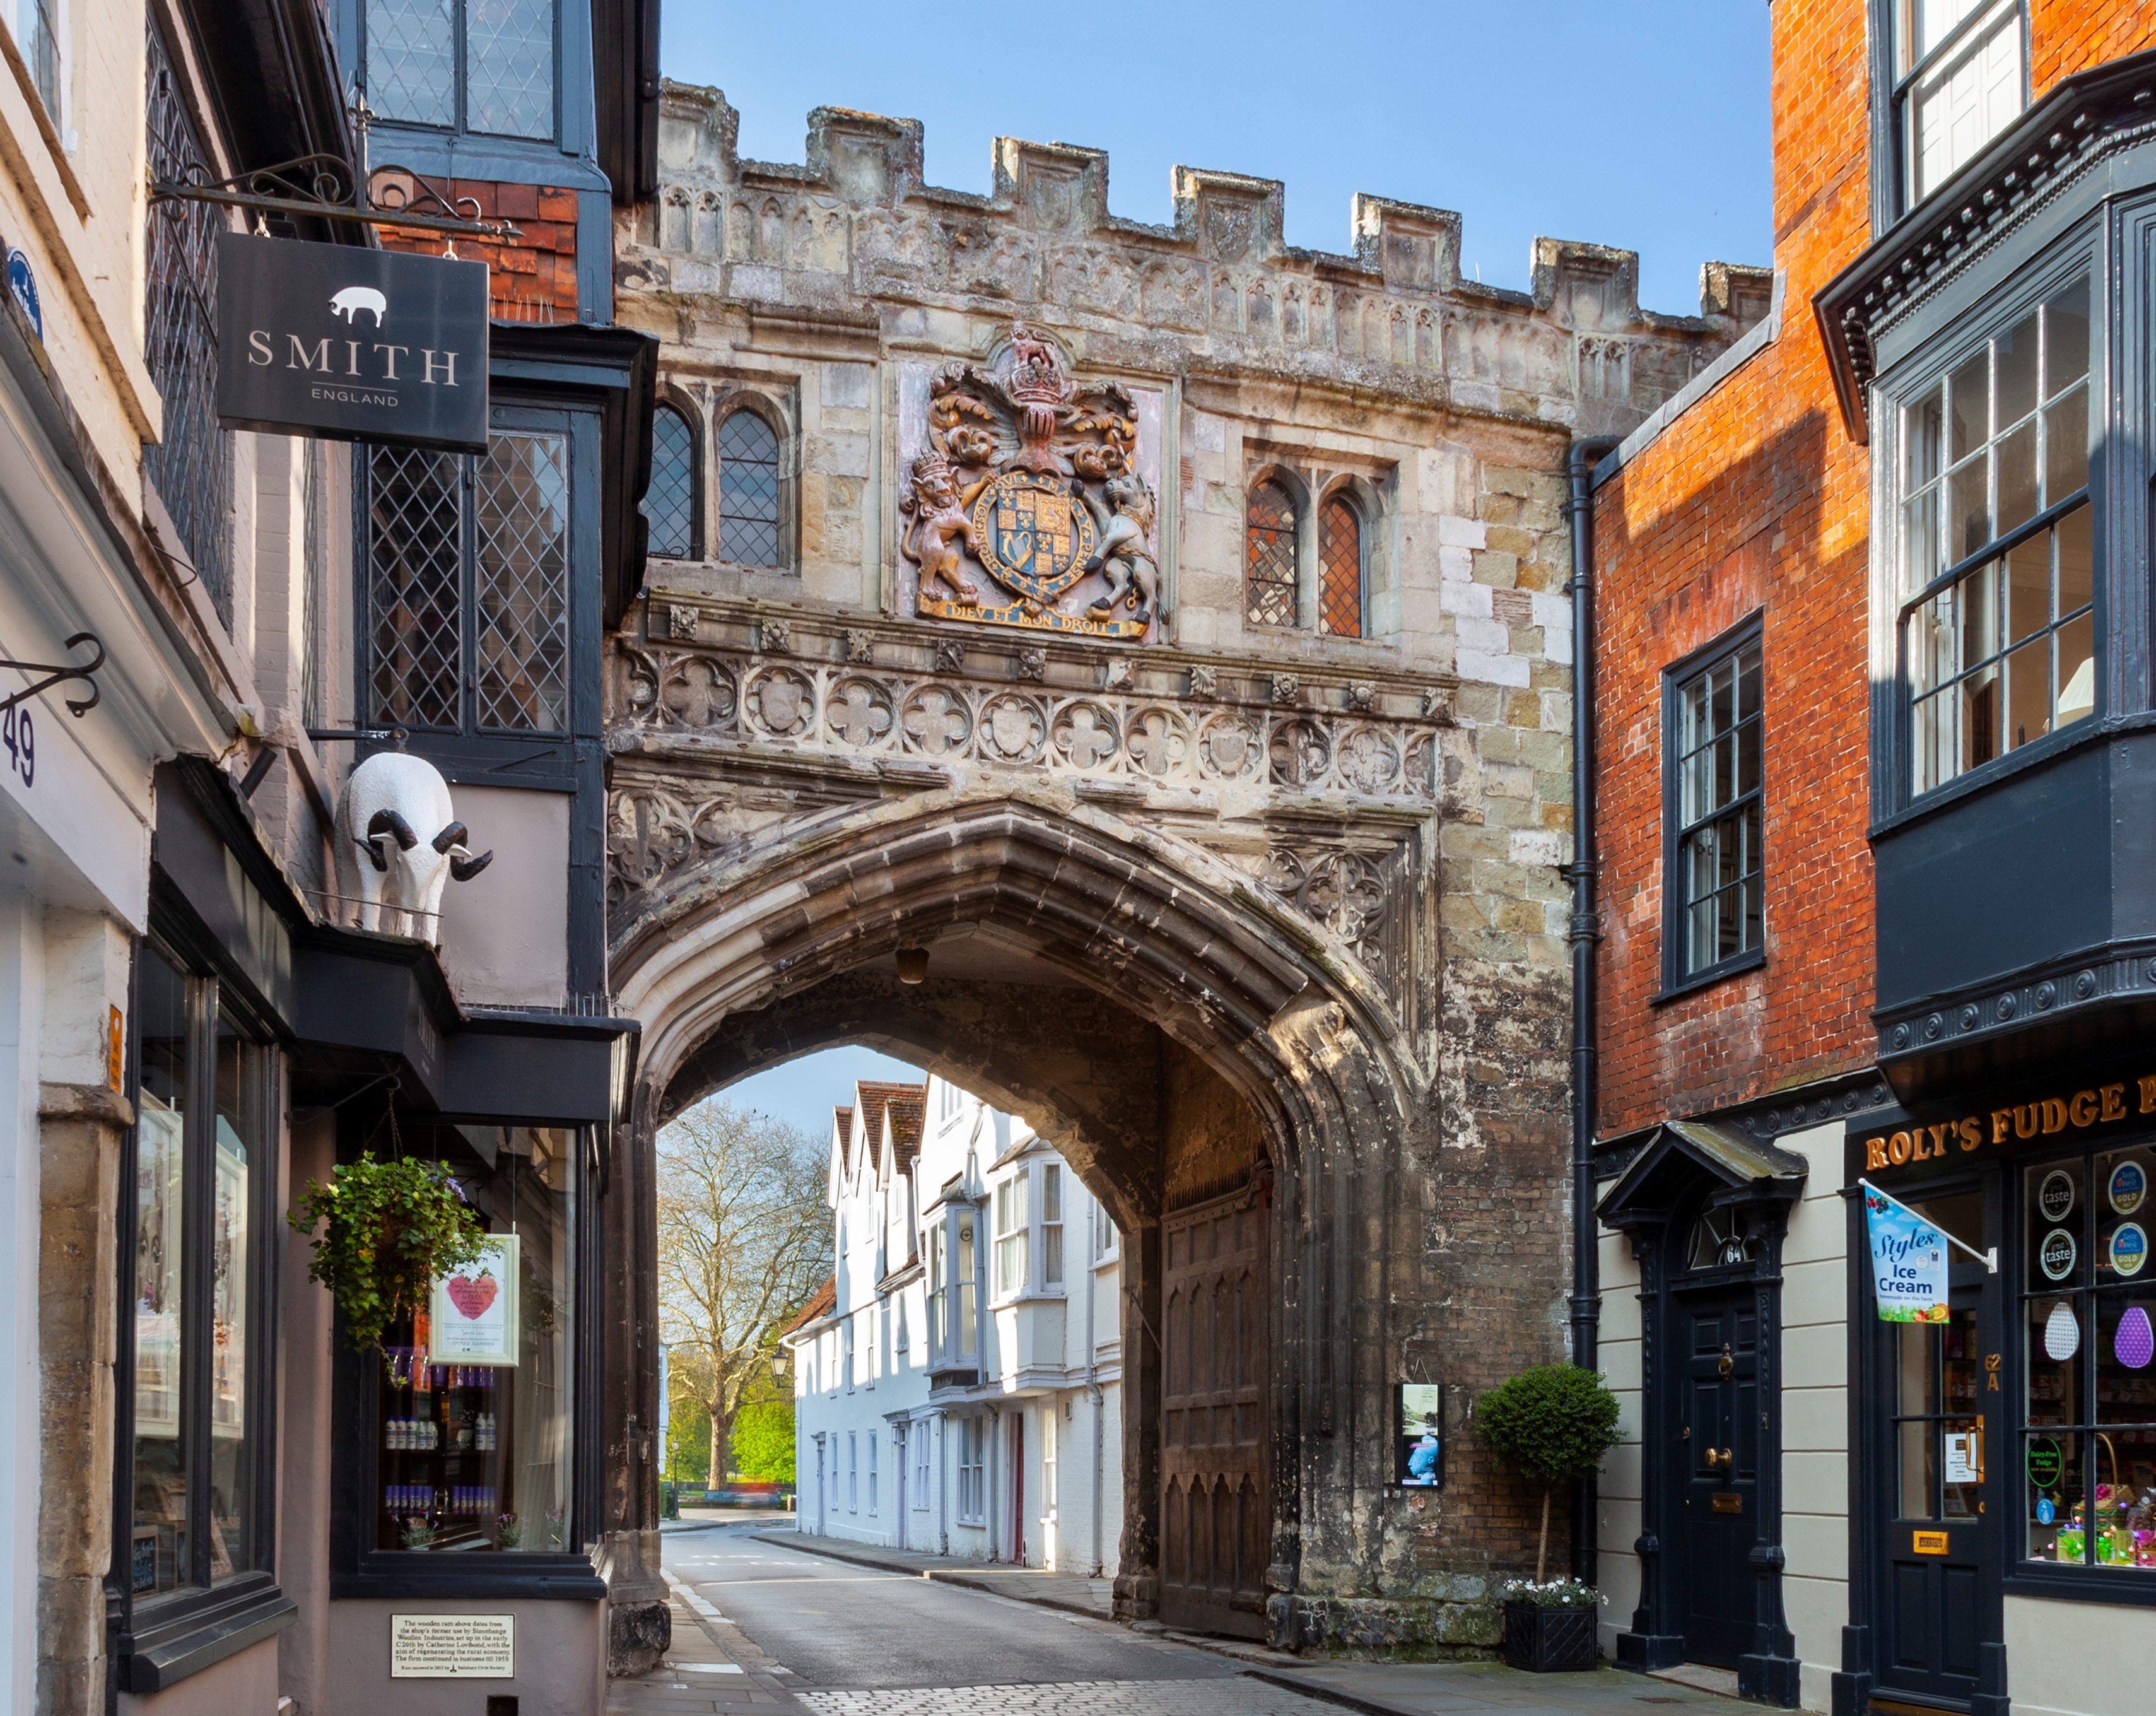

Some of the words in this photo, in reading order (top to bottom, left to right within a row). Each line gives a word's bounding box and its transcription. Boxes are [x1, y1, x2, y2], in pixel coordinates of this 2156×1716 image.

[248, 330, 459, 387] SMITH
[312, 388, 399, 408] ENGLAND
[993, 609, 1012, 621] ET
[1019, 613, 1053, 627] MON
[1062, 616, 1111, 632] DROIT
[3, 691, 35, 789] 49
[1866, 1116, 1982, 1171] ROLY'S
[1991, 1083, 2126, 1144] FUDGE
[2045, 1190, 2070, 1204] taste
[2117, 1194, 2137, 1203] GOLD
[1727, 1244, 1741, 1263] 64
[1875, 1228, 1935, 1263] Styles
[2051, 1242, 2065, 1252] great
[2046, 1249, 2071, 1262] taste
[1893, 1264, 1917, 1279] Ice
[1879, 1278, 1933, 1294] Cream
[1985, 1353, 2001, 1372] 62
[1988, 1373, 1999, 1392] A
